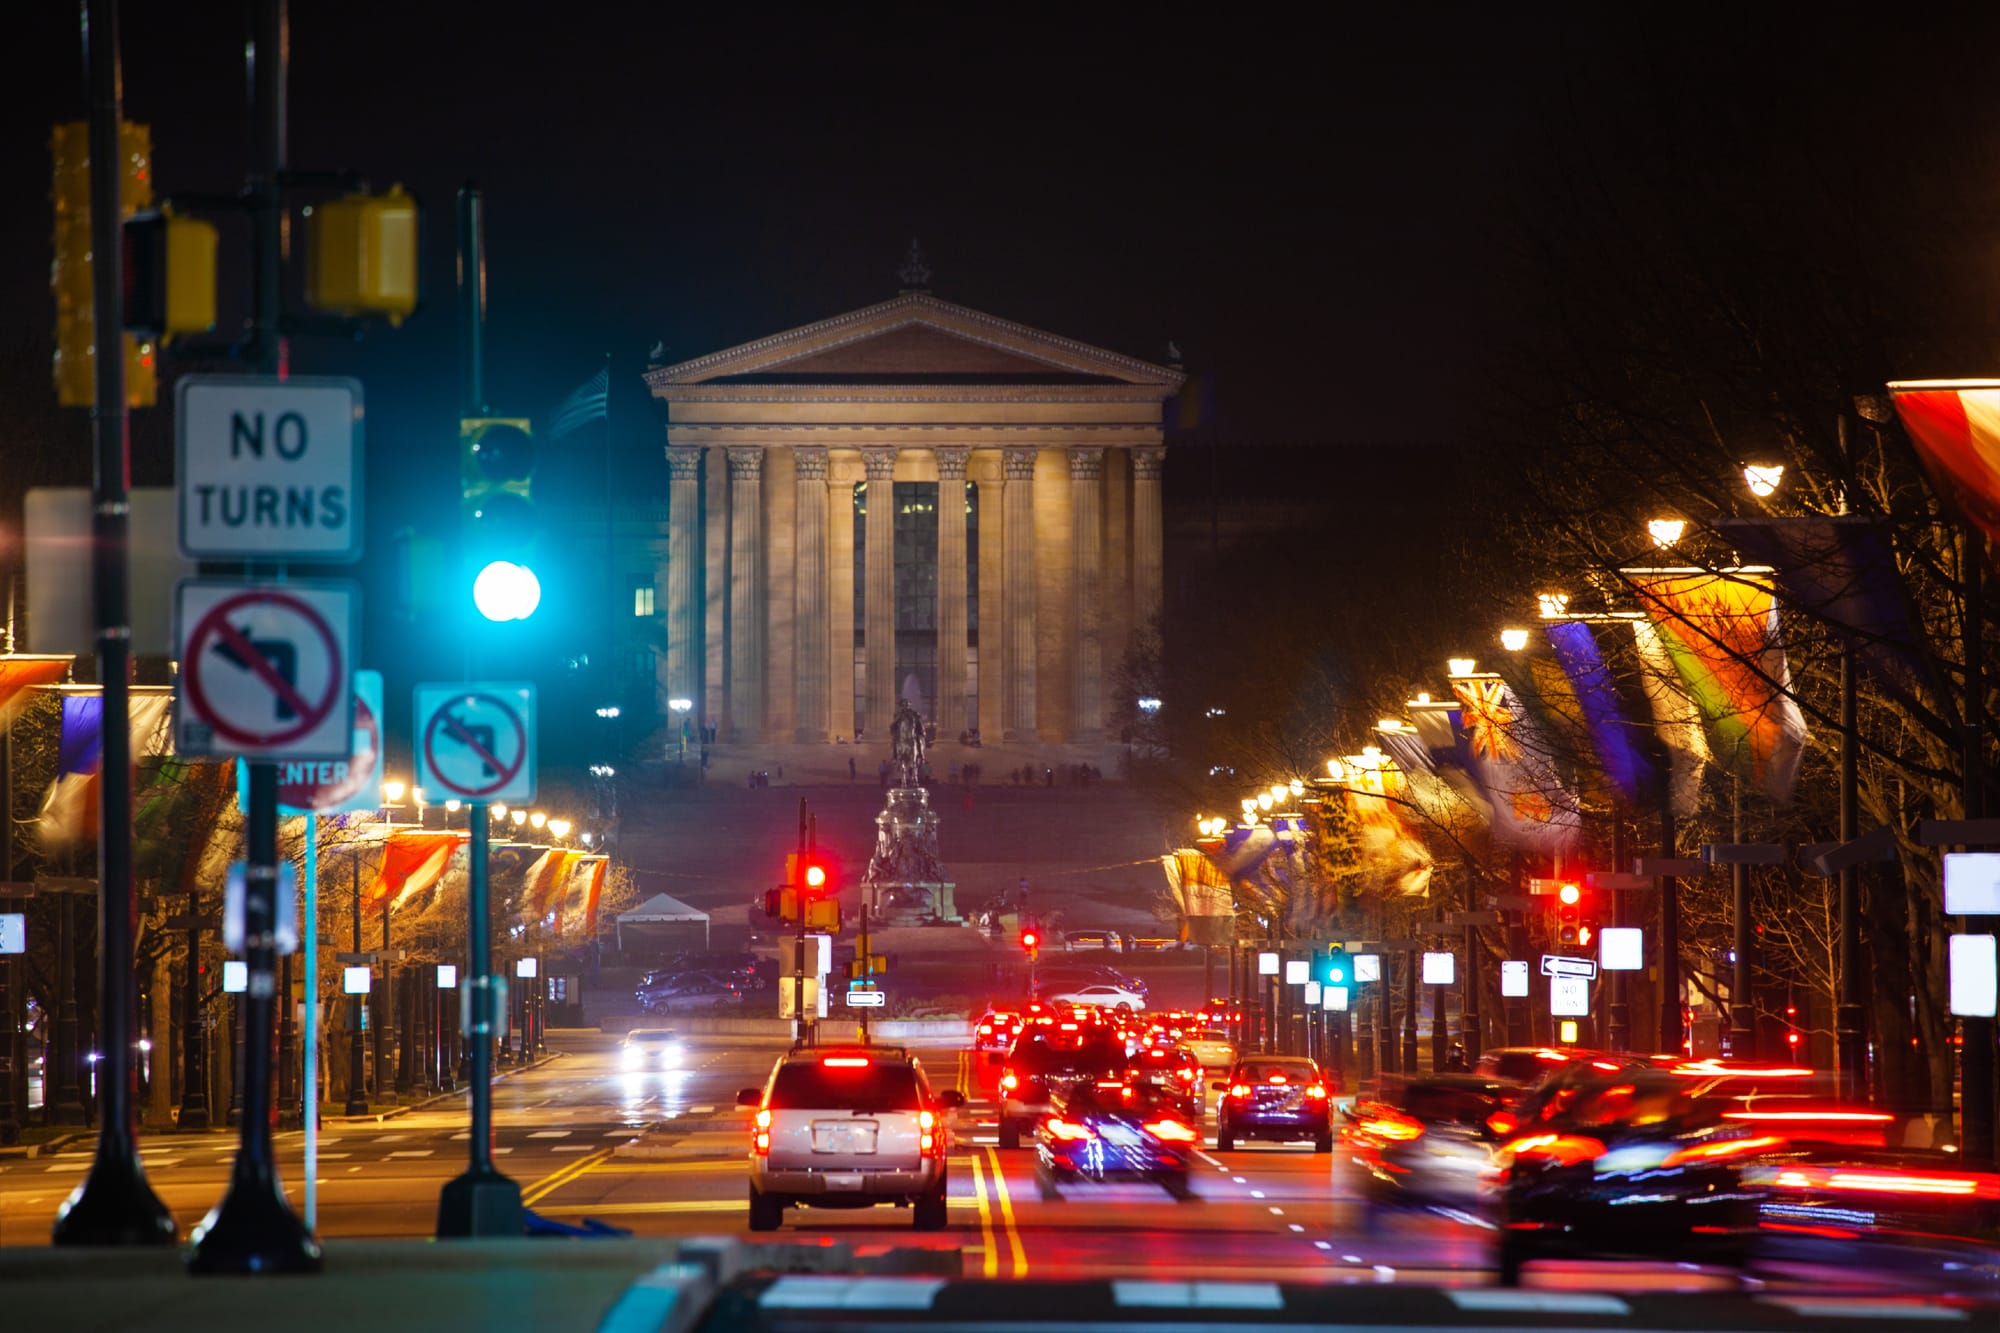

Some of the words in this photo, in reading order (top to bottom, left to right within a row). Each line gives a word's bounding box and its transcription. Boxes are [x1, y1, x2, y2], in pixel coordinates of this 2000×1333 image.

[230, 409, 310, 461] NO
[194, 483, 348, 531] TURNS
[1561, 985, 1577, 994] NO
